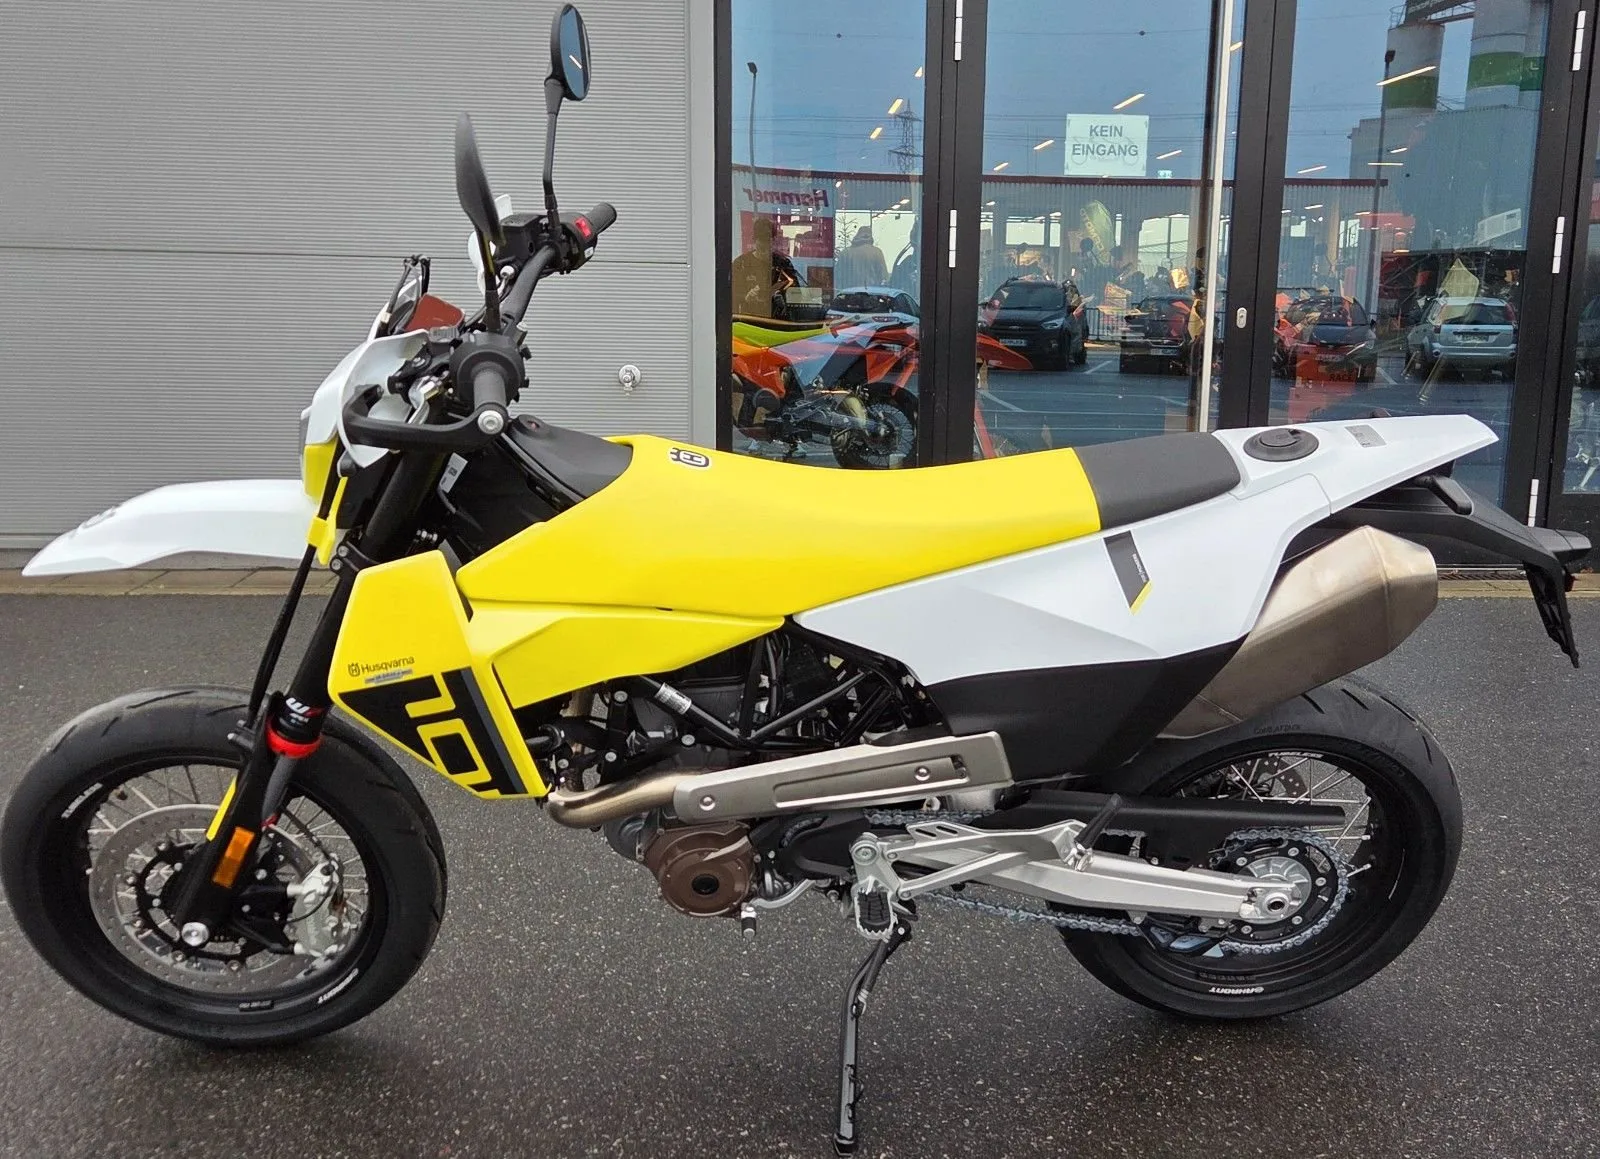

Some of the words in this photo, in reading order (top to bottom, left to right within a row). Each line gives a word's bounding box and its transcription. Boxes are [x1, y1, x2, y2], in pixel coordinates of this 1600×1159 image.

[1089, 125, 1123, 137] KEIN
[1072, 143, 1139, 156] EINGANG
[361, 656, 415, 674] Husqvarna
